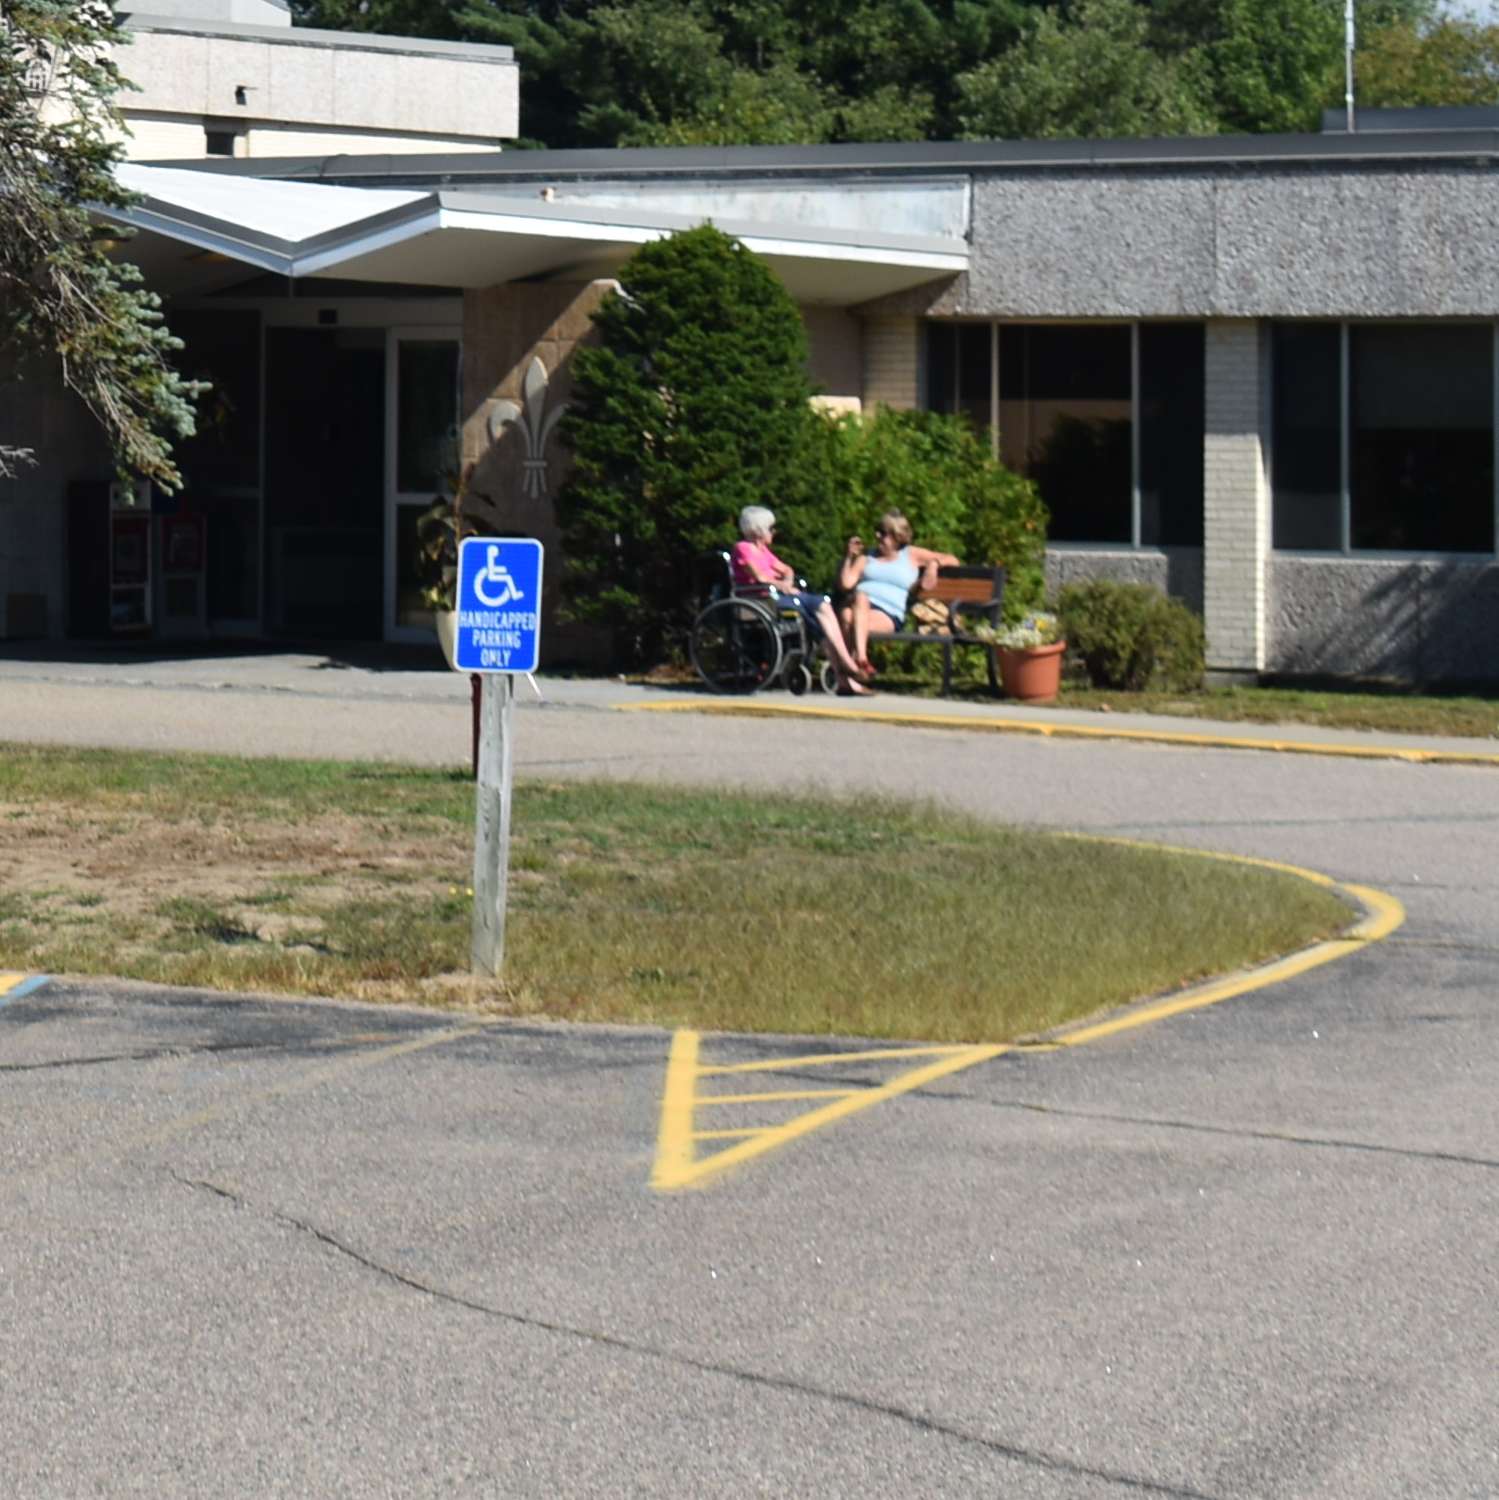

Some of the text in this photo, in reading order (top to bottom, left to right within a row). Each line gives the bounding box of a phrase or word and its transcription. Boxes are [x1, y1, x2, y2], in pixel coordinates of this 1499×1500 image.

[459, 610, 536, 631] HANDICAPPED
[472, 628, 521, 649] PARKING
[480, 648, 511, 667] ONLY
